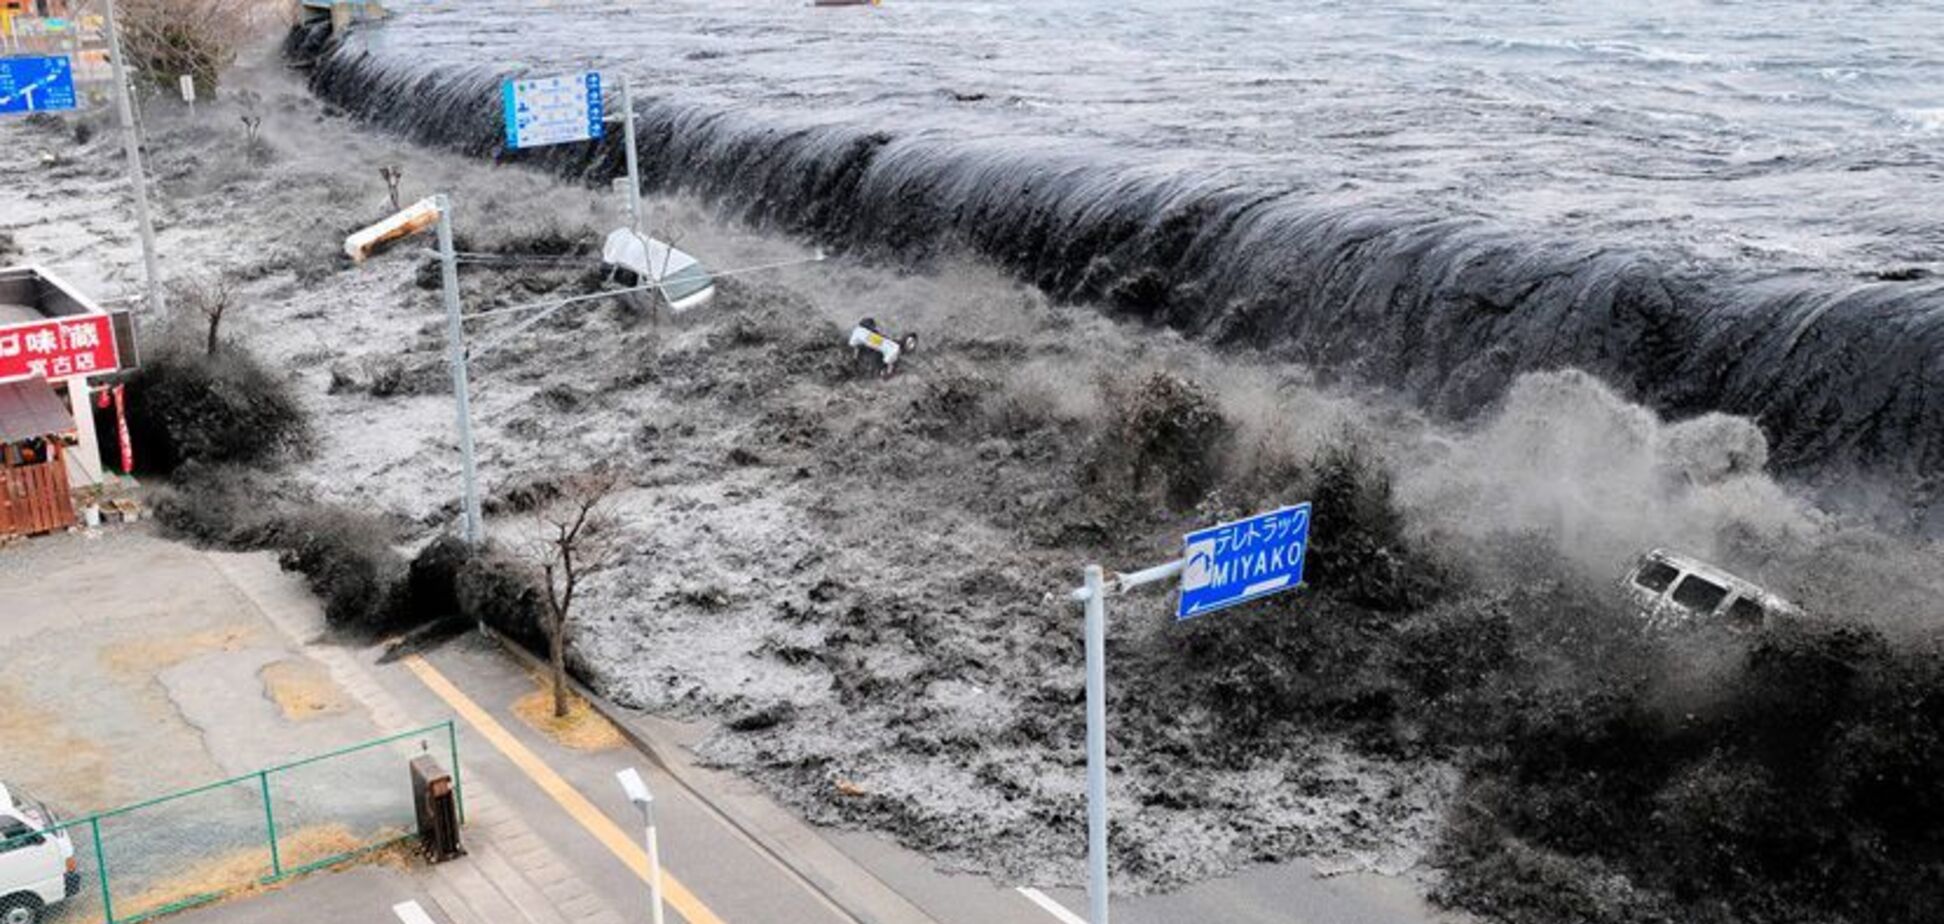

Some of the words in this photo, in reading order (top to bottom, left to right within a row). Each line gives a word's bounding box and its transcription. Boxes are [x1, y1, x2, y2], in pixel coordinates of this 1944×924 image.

[26, 352, 95, 377] 宮古店
[1216, 509, 1306, 554] テレトラック
[1211, 541, 1300, 588] MIYAKO
